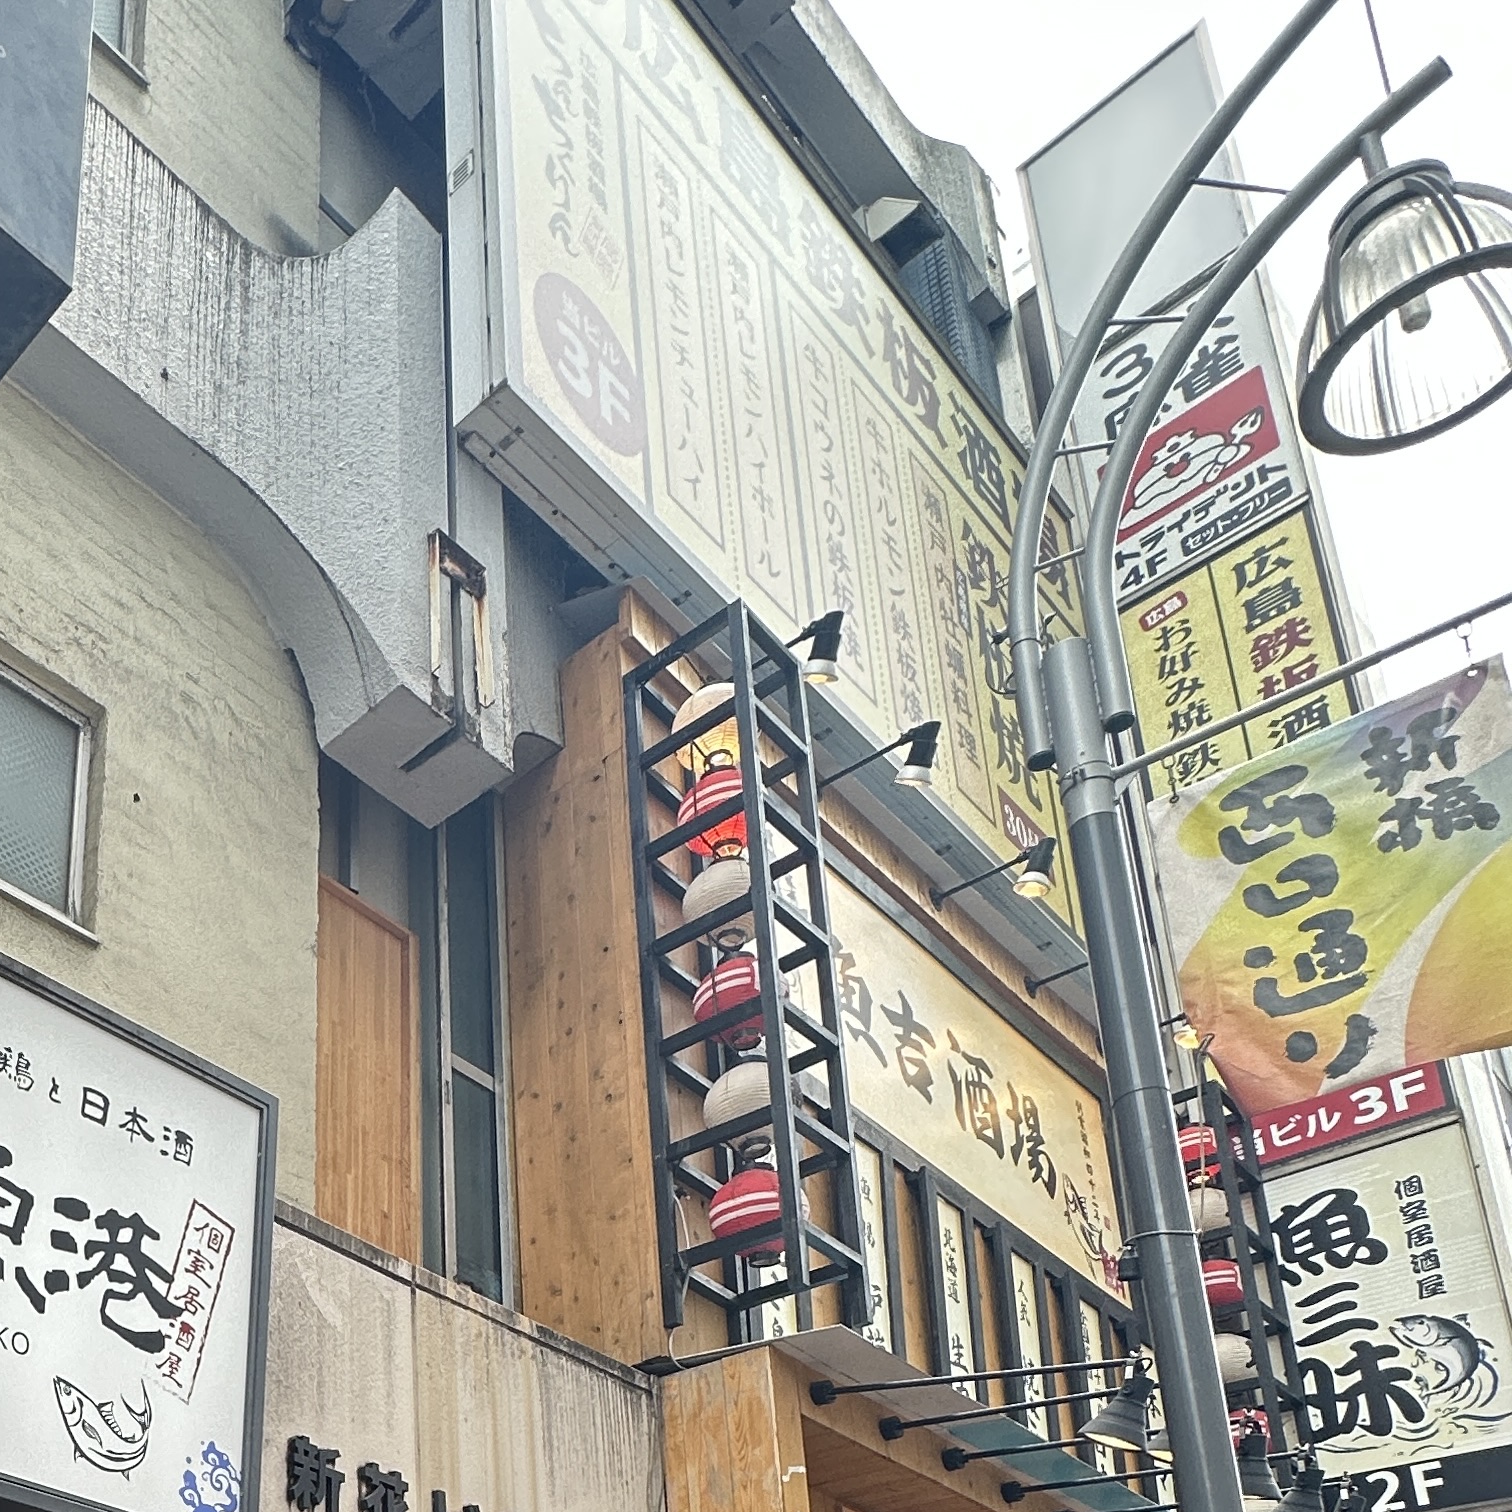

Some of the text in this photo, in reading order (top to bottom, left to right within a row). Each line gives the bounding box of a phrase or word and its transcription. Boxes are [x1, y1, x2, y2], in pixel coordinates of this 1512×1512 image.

[553, 312, 631, 450] 3F
[1116, 463, 1288, 570] トライデント
[1120, 549, 1168, 592] 4F
[1360, 706, 1499, 854] 新橋
[1218, 763, 1379, 1079] 西口通り
[1349, 1069, 1427, 1126] 3F
[1394, 1174, 1448, 1300] 個室居酒屋
[155, 1220, 226, 1389] 個室居酒屋
